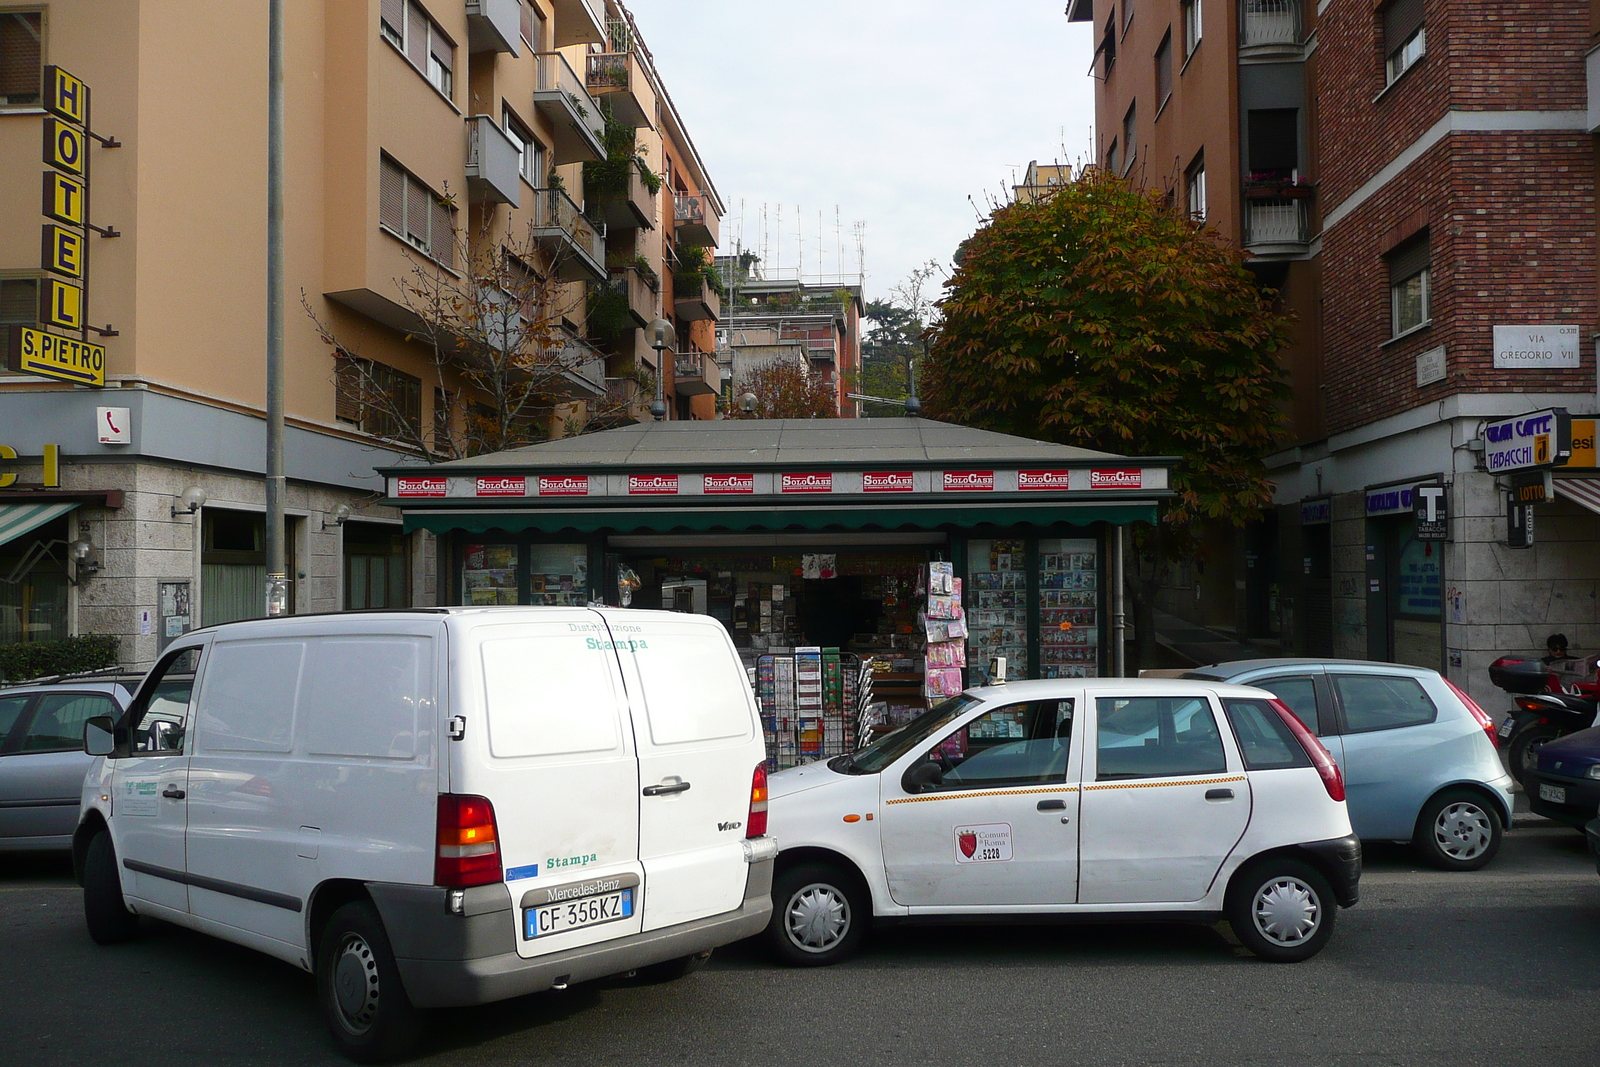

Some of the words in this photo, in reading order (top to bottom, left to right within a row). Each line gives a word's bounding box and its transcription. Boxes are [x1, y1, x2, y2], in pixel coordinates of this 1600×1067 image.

[58, 74, 79, 323] HOTEL
[1528, 335, 1545, 344] VIA
[1500, 350, 1553, 360] GREGORIO
[1561, 350, 1574, 360] VII
[1488, 446, 1532, 469] TABACCHI
[1520, 485, 1544, 501] LOTTO
[1420, 488, 1443, 522] T
[585, 637, 648, 653] Stampa
[979, 831, 1009, 839] Comune
[984, 839, 1006, 847] Roma
[546, 853, 597, 869] Stampa
[983, 848, 1000, 860] 5228
[547, 879, 620, 902] Mercedes-Benz
